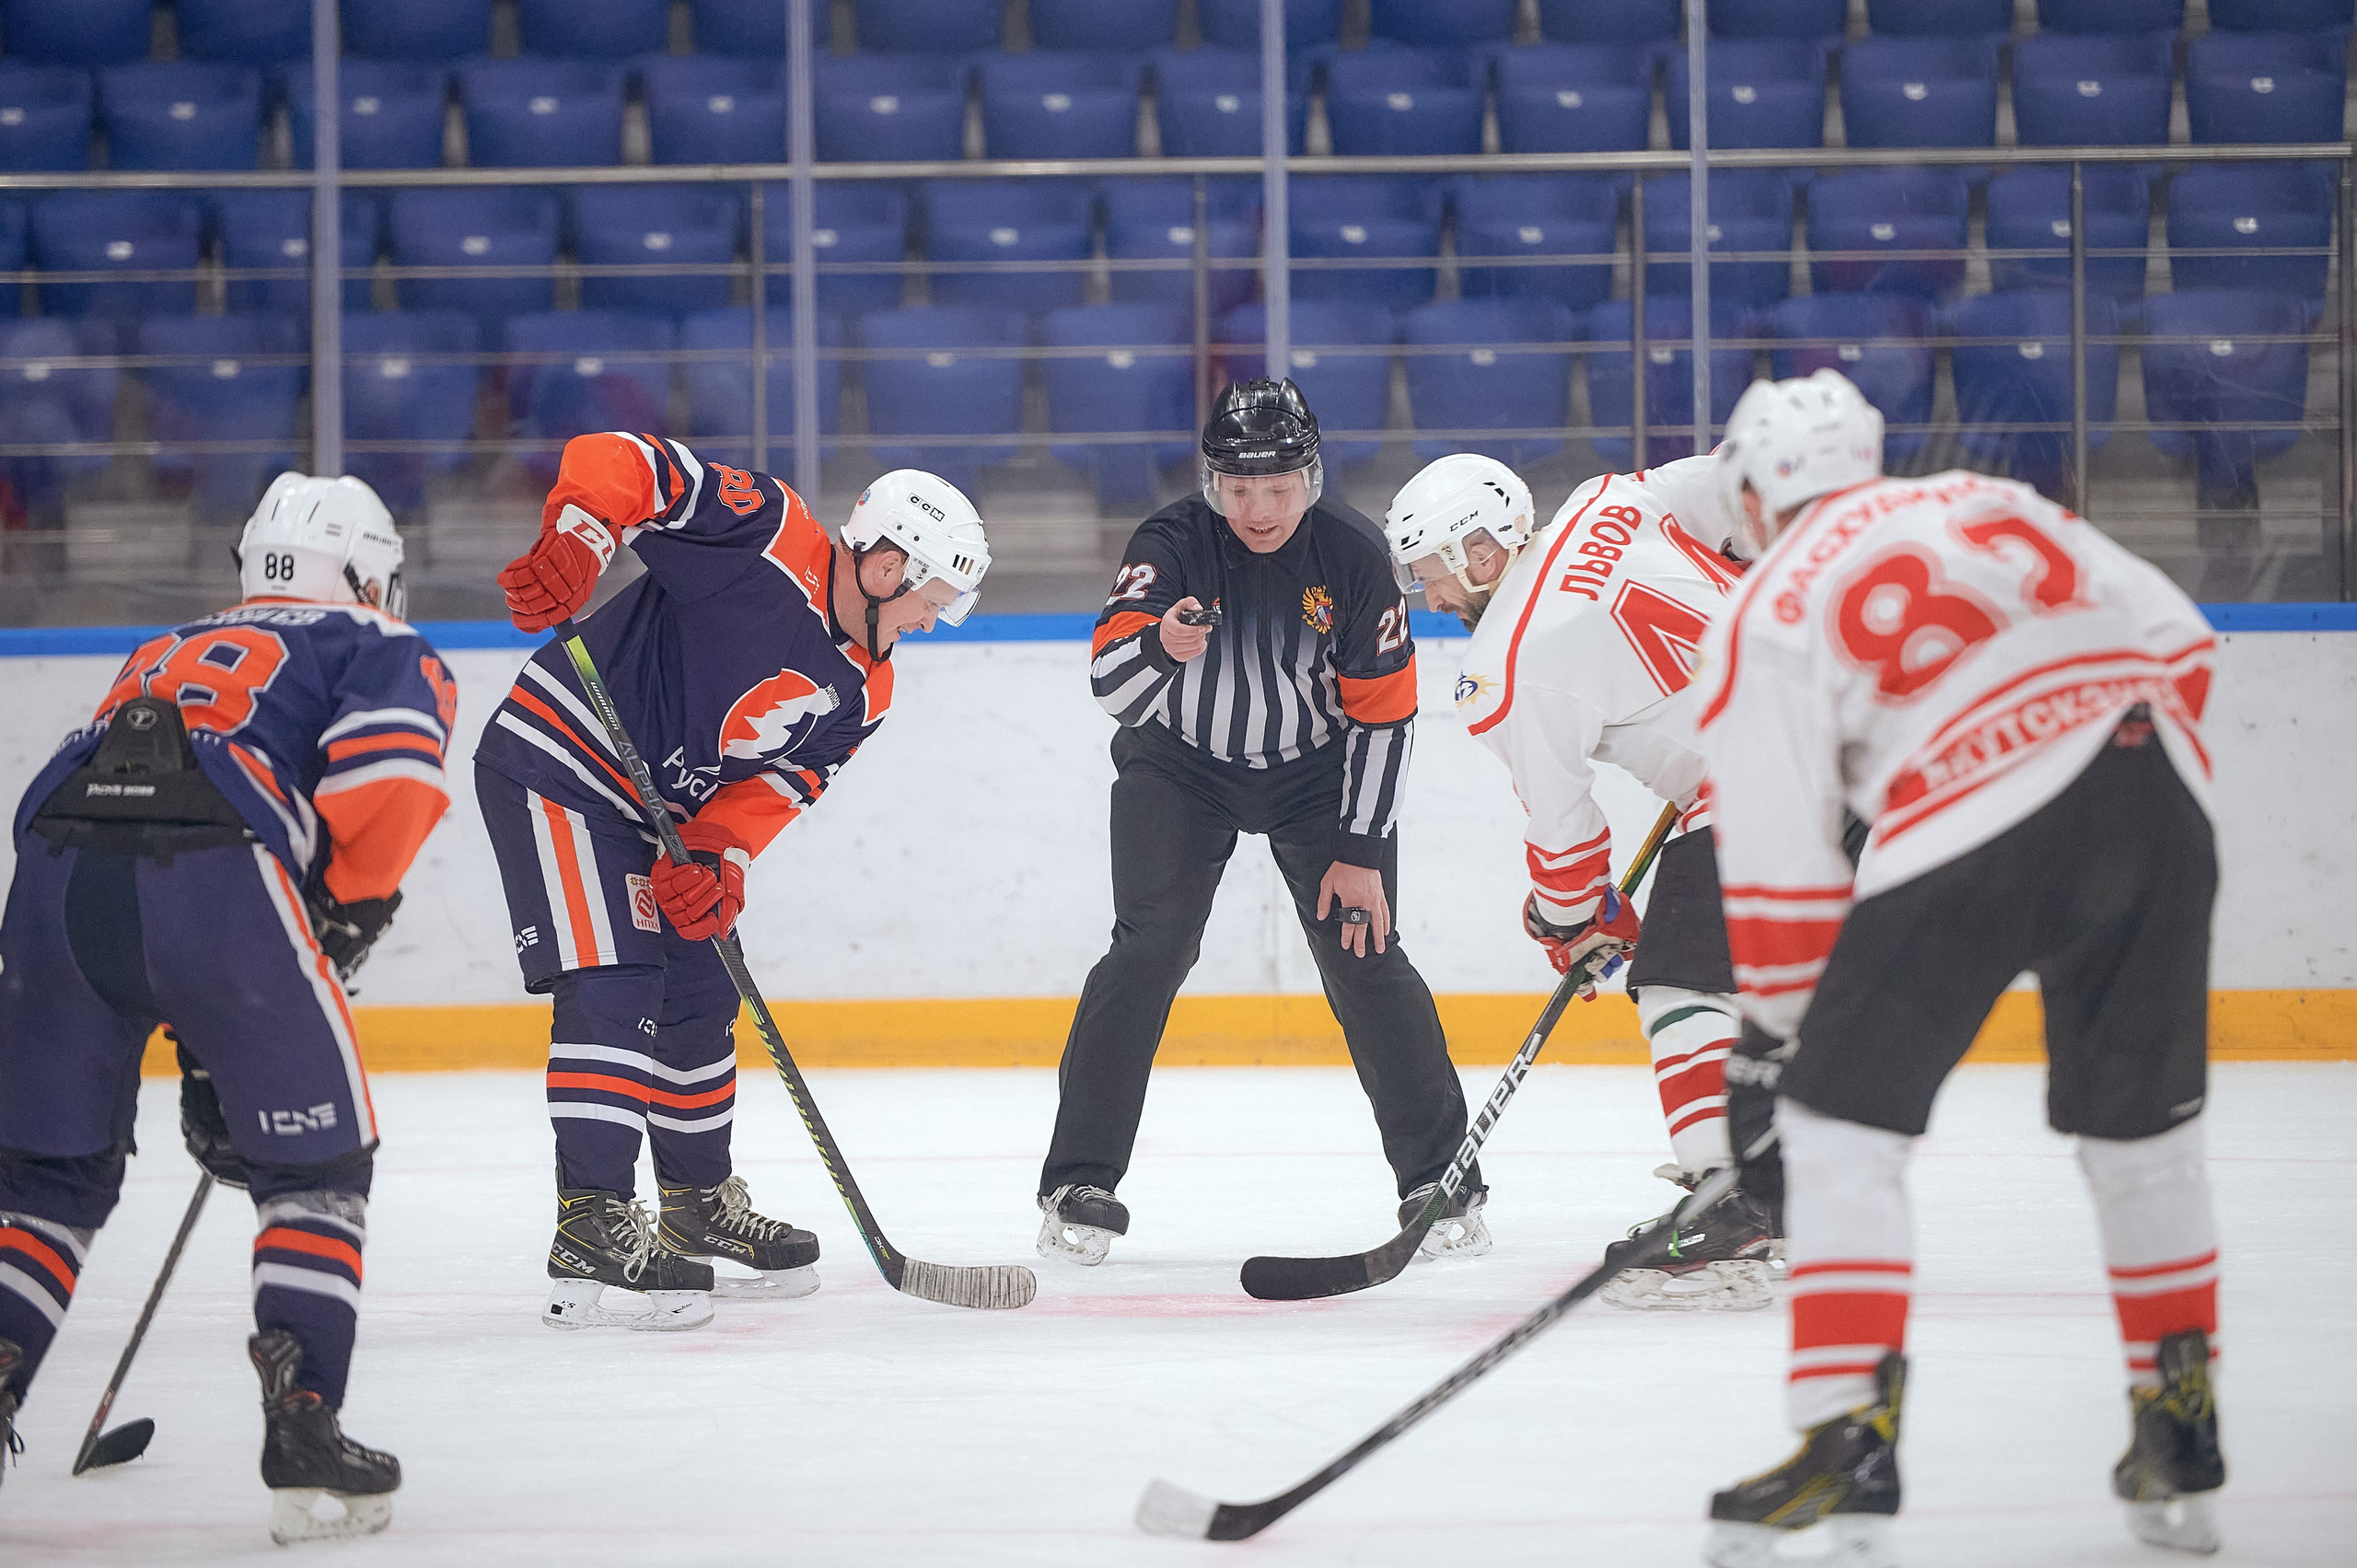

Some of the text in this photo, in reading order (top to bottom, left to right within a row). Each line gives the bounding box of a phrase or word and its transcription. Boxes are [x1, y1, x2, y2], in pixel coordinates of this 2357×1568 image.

[1237, 449, 1277, 459] BAUER
[906, 492, 946, 522] CCM
[1449, 510, 1479, 532] CCM
[265, 552, 294, 581] 88
[1559, 505, 1643, 602] ЛЬВОВ
[590, 681, 620, 731] WARRIOR
[618, 740, 666, 819] ALPHA
[1439, 1052, 1532, 1199] BAUER
[552, 1242, 598, 1274] CCM
[703, 1235, 747, 1255] CCM
